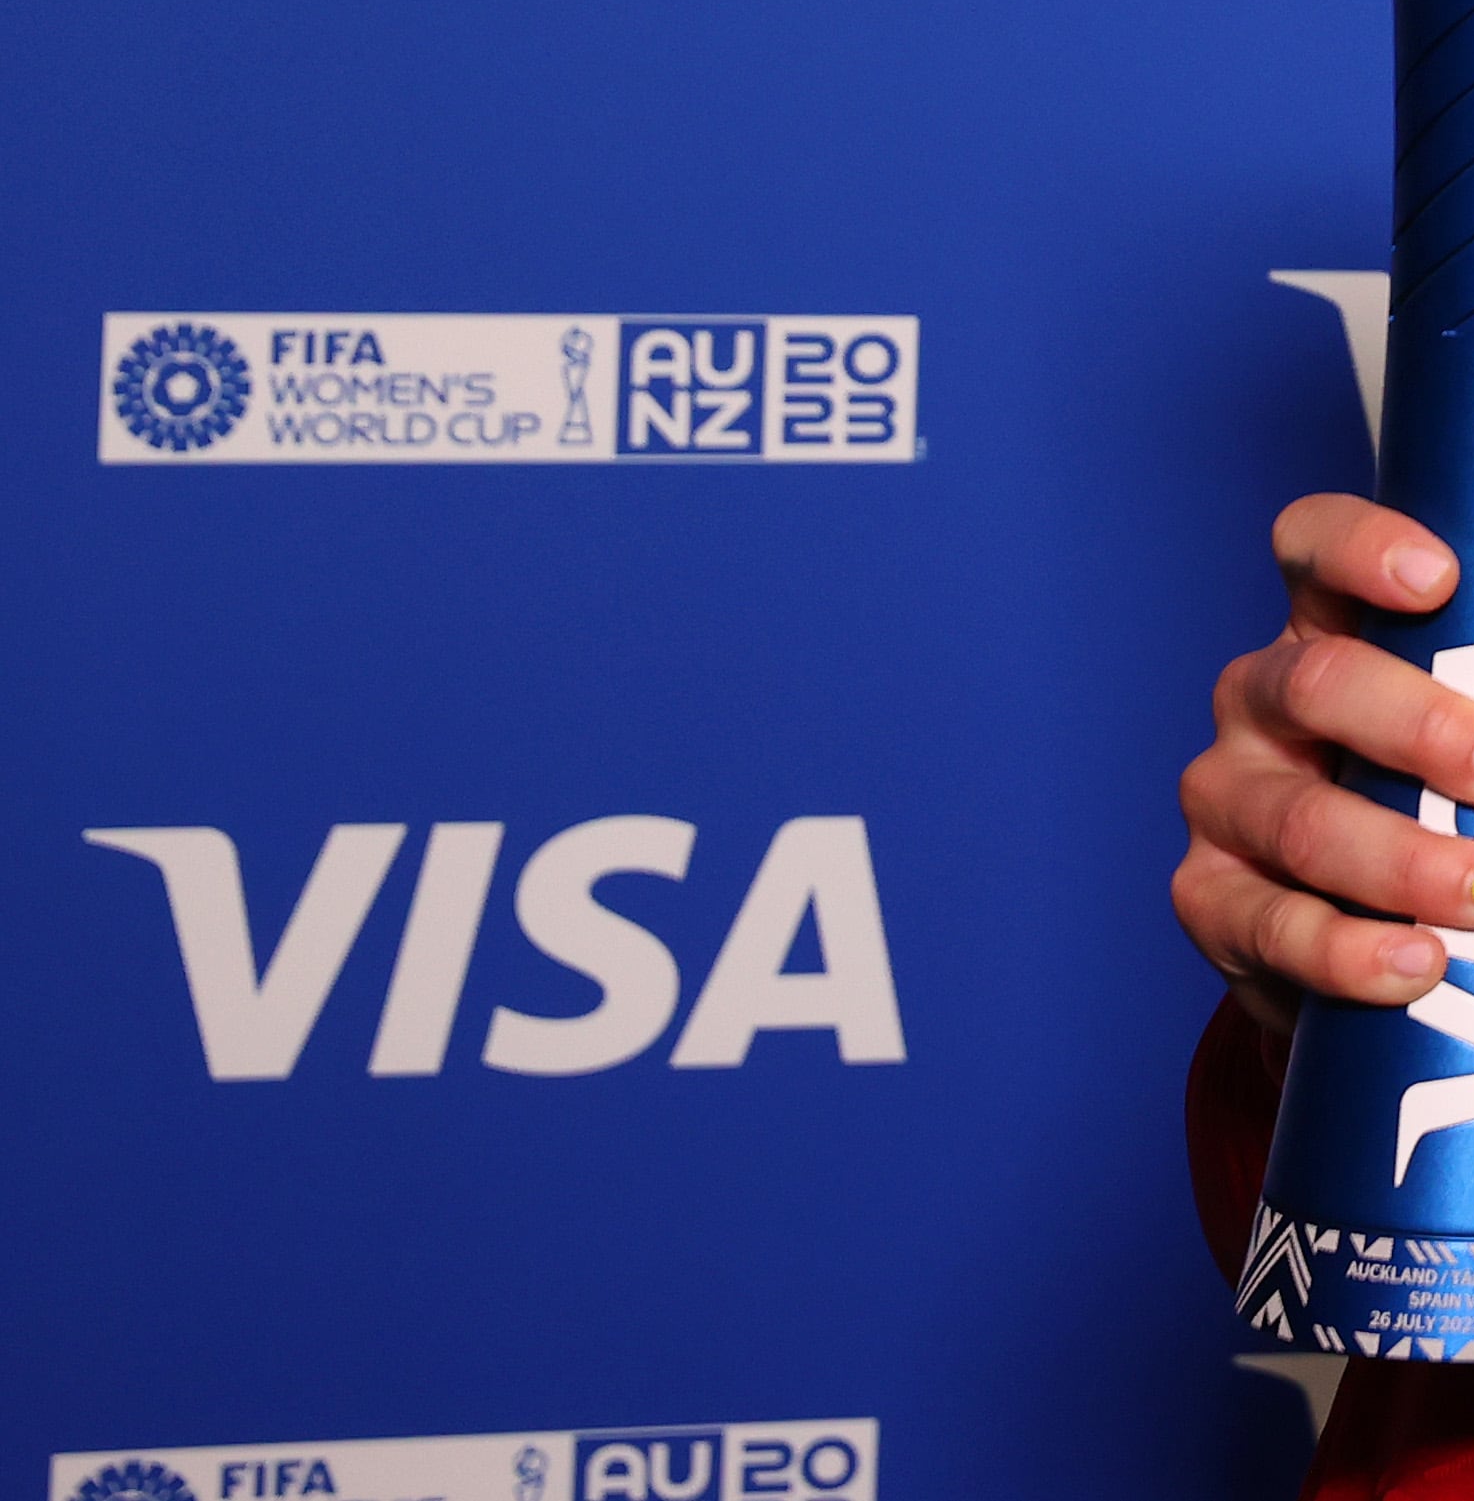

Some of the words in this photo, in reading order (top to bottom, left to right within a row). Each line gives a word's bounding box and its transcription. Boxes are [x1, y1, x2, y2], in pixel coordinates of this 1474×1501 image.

[268, 329, 387, 367] FIFA
[629, 329, 754, 385] AU
[782, 333, 901, 386] 20
[268, 372, 496, 407] WOMEN'S
[267, 412, 440, 447] WORLD
[447, 413, 541, 448] CUP
[629, 389, 753, 448] NZ
[780, 393, 897, 446] 23
[82, 814, 908, 1082] VISA
[1345, 1260, 1438, 1286] AUCKLAND
[1440, 1271, 1449, 1285] /
[1368, 1310, 1392, 1329] 26
[1392, 1312, 1437, 1332] JULY
[1408, 1290, 1462, 1310] SPAIN
[220, 1458, 337, 1498] FIFA
[586, 1442, 715, 1501] AU
[741, 1436, 859, 1493] 20
